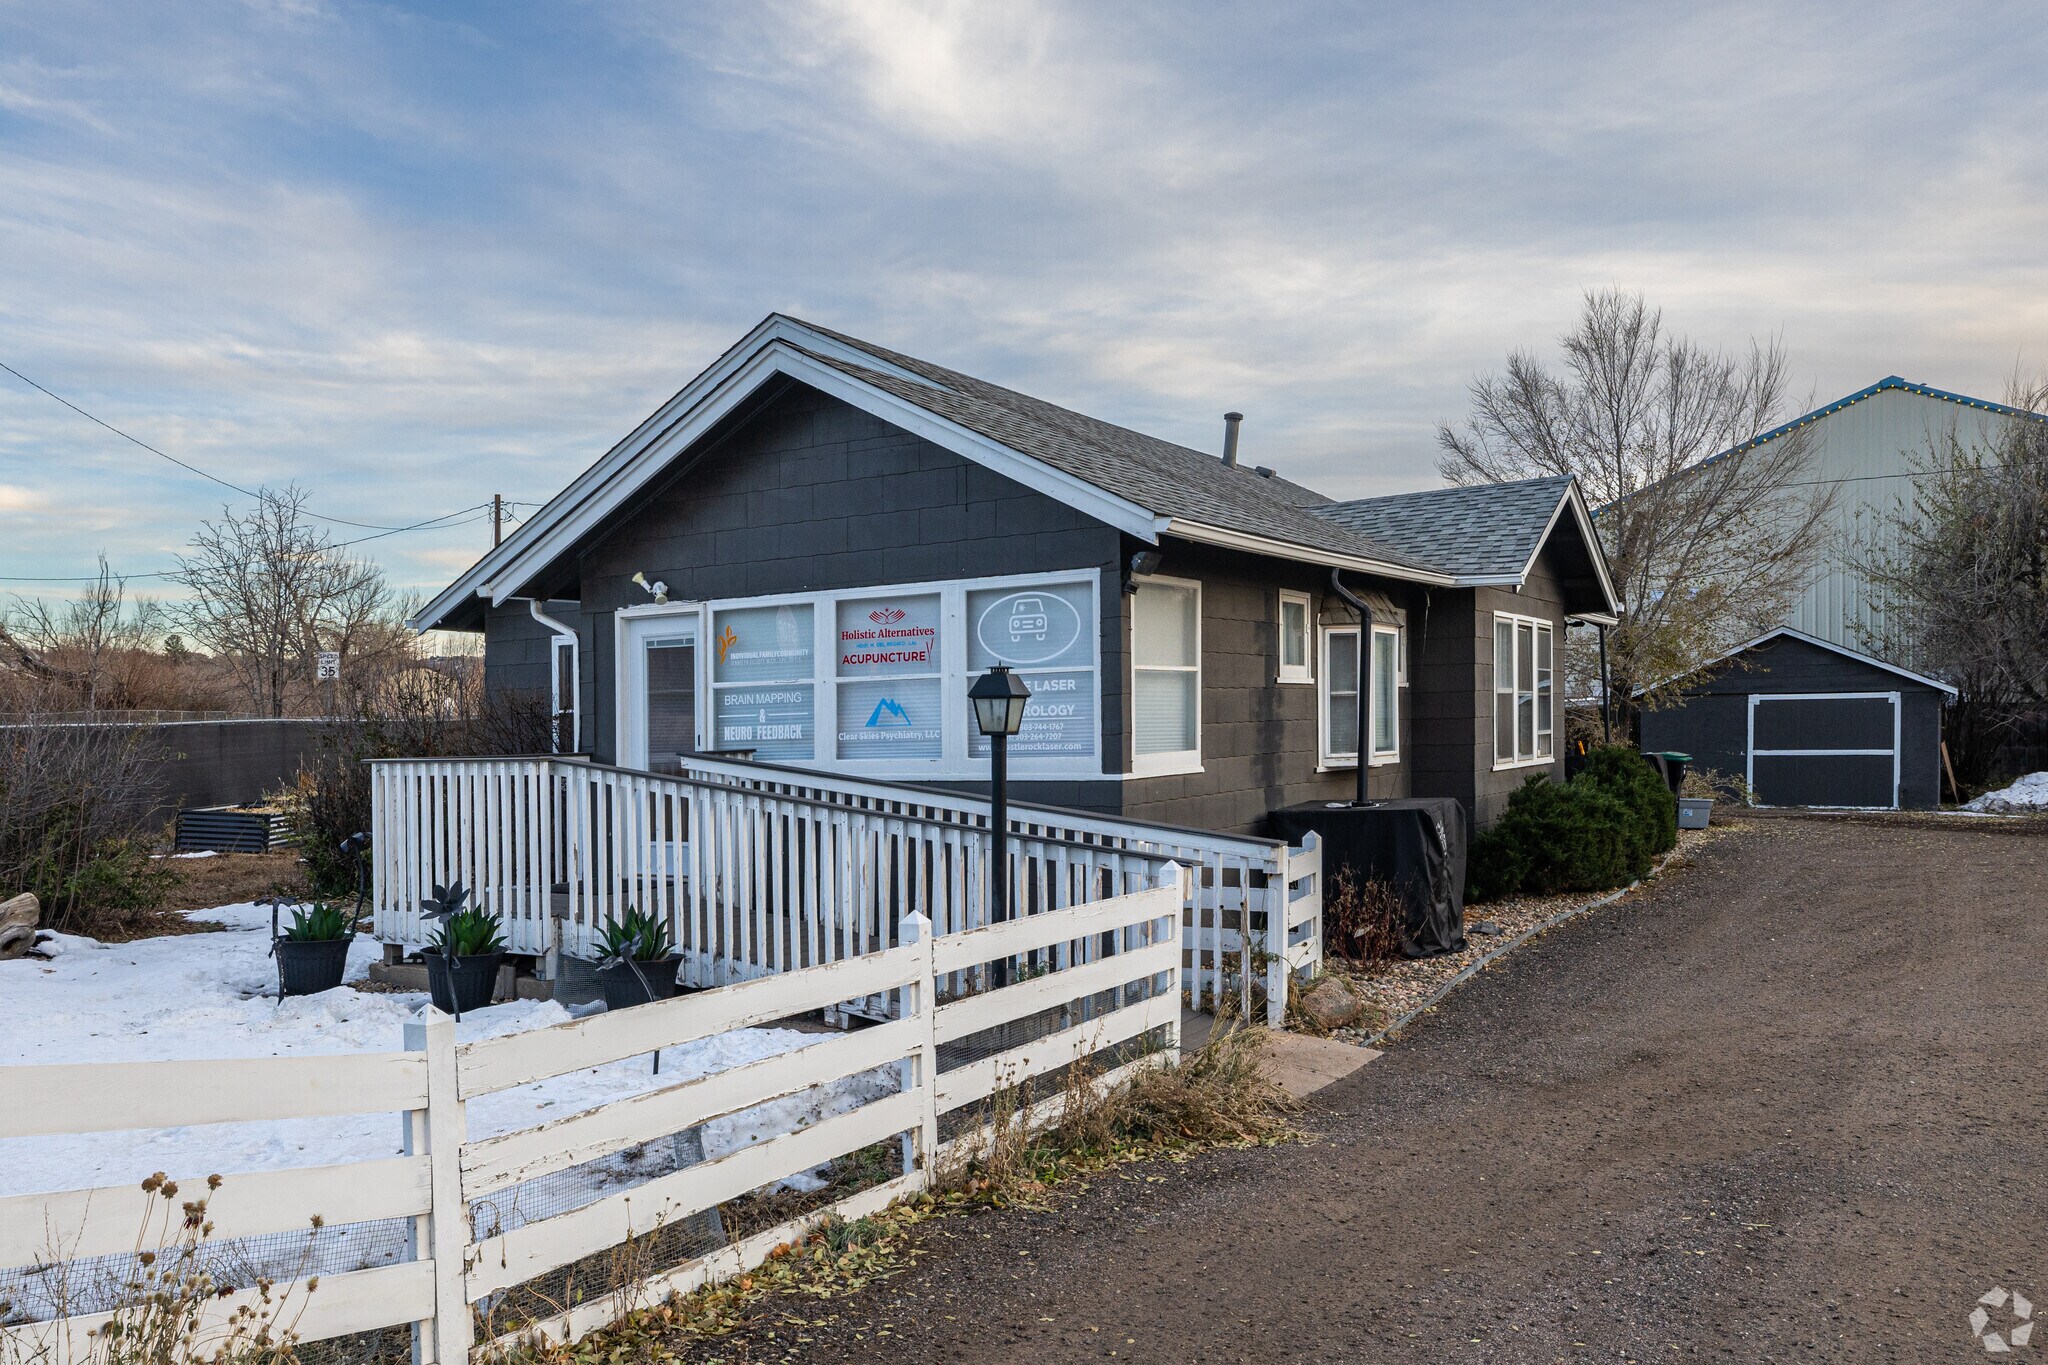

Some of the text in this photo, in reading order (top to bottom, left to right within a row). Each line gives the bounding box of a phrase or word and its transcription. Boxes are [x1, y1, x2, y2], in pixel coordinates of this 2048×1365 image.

[841, 626, 935, 640] Holistic Alternatives
[843, 651, 926, 664] ACUPUNCTURE
[321, 666, 336, 677] 35
[1034, 679, 1076, 691] LASER
[724, 692, 802, 706] BRAIN MAPPING
[759, 708, 766, 723] &
[1023, 704, 1075, 717] ROLOGY
[724, 724, 802, 741] NEURO FEEDBACK
[838, 730, 941, 741] Clear Skies Psychiatry, LLC
